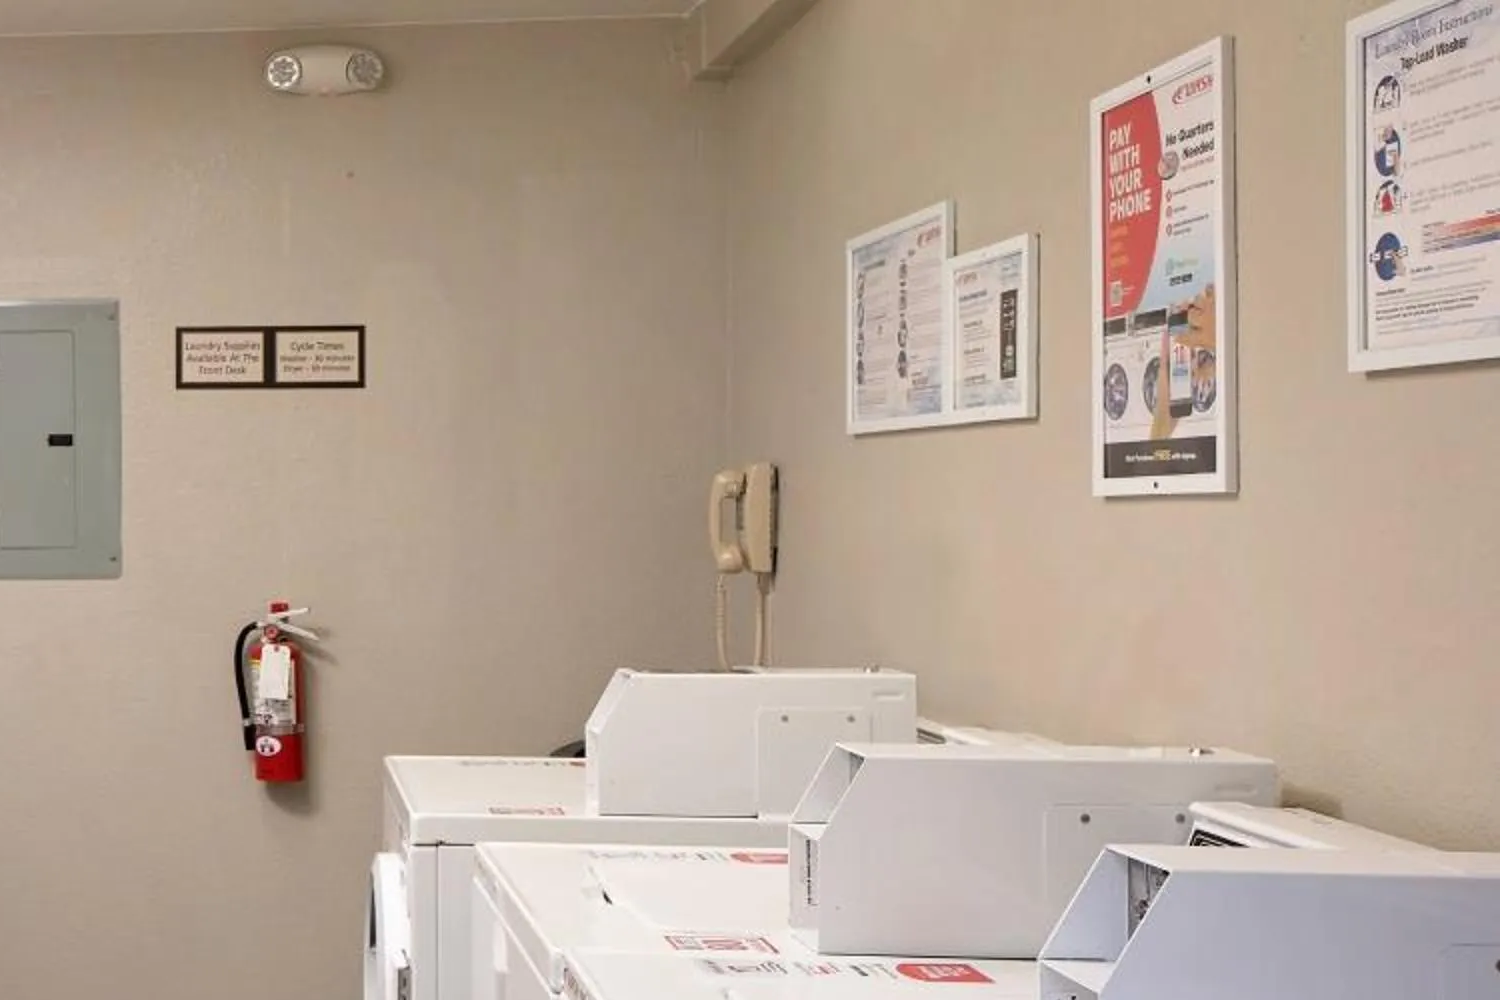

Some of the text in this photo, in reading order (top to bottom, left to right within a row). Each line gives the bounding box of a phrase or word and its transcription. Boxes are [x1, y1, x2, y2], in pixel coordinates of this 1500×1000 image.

[1108, 123, 1132, 147] PAY
[1180, 120, 1215, 144] Quarters
[1108, 143, 1141, 173] WITH
[1183, 137, 1215, 160] Needed
[1108, 167, 1143, 198] YOUR
[1108, 189, 1153, 224] PHONE
